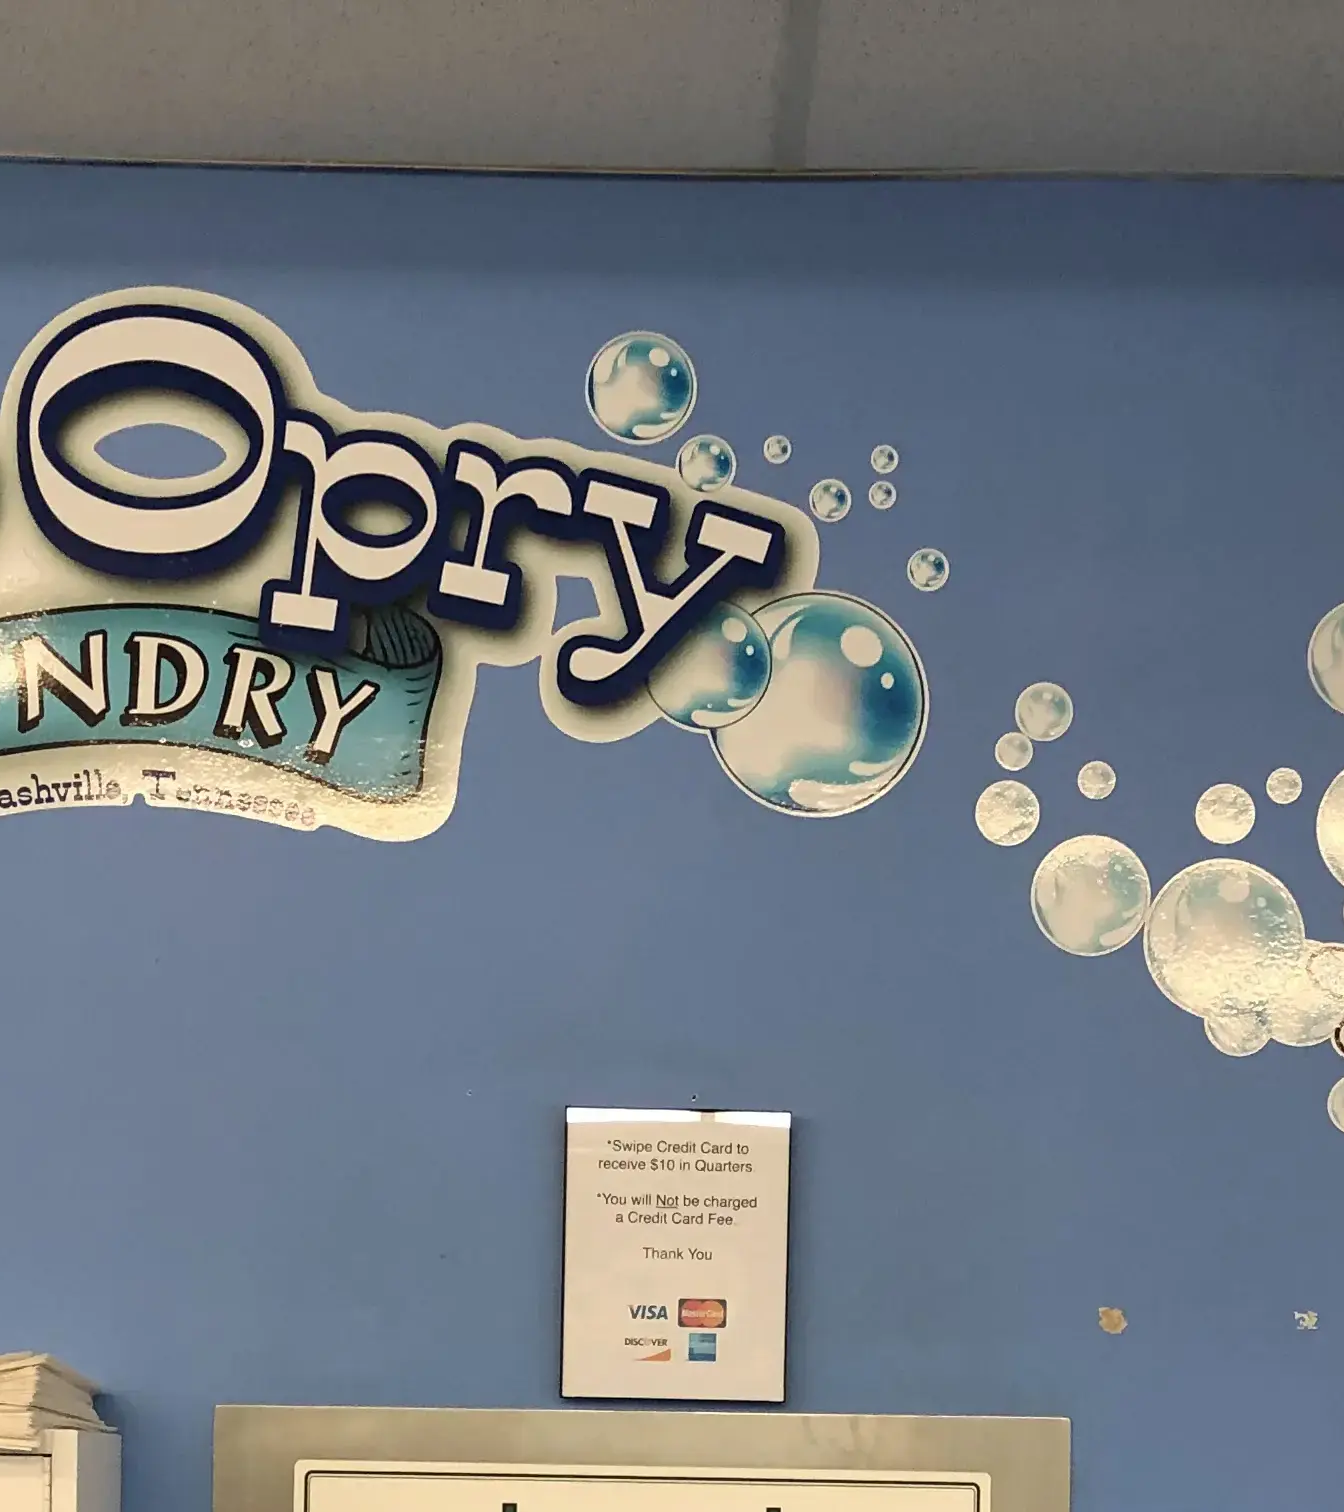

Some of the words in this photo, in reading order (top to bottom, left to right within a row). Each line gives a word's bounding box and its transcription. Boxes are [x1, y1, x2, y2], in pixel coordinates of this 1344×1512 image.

[16, 302, 786, 706] Opry
[656, 1140, 696, 1154] Credit
[700, 1141, 733, 1155] Card
[736, 1143, 750, 1155] to
[598, 1158, 646, 1171] receive
[650, 1158, 675, 1172] $10
[679, 1159, 691, 1171] in
[631, 1193, 652, 1206] will
[656, 1194, 679, 1207] Not
[683, 1195, 700, 1208] be
[703, 1196, 758, 1211] charged
[615, 1213, 624, 1224] a
[628, 1211, 668, 1225] Credit
[671, 1212, 704, 1226] Card
[643, 1247, 684, 1260] Thank
[688, 1248, 713, 1261] You
[628, 1305, 668, 1320] VISA
